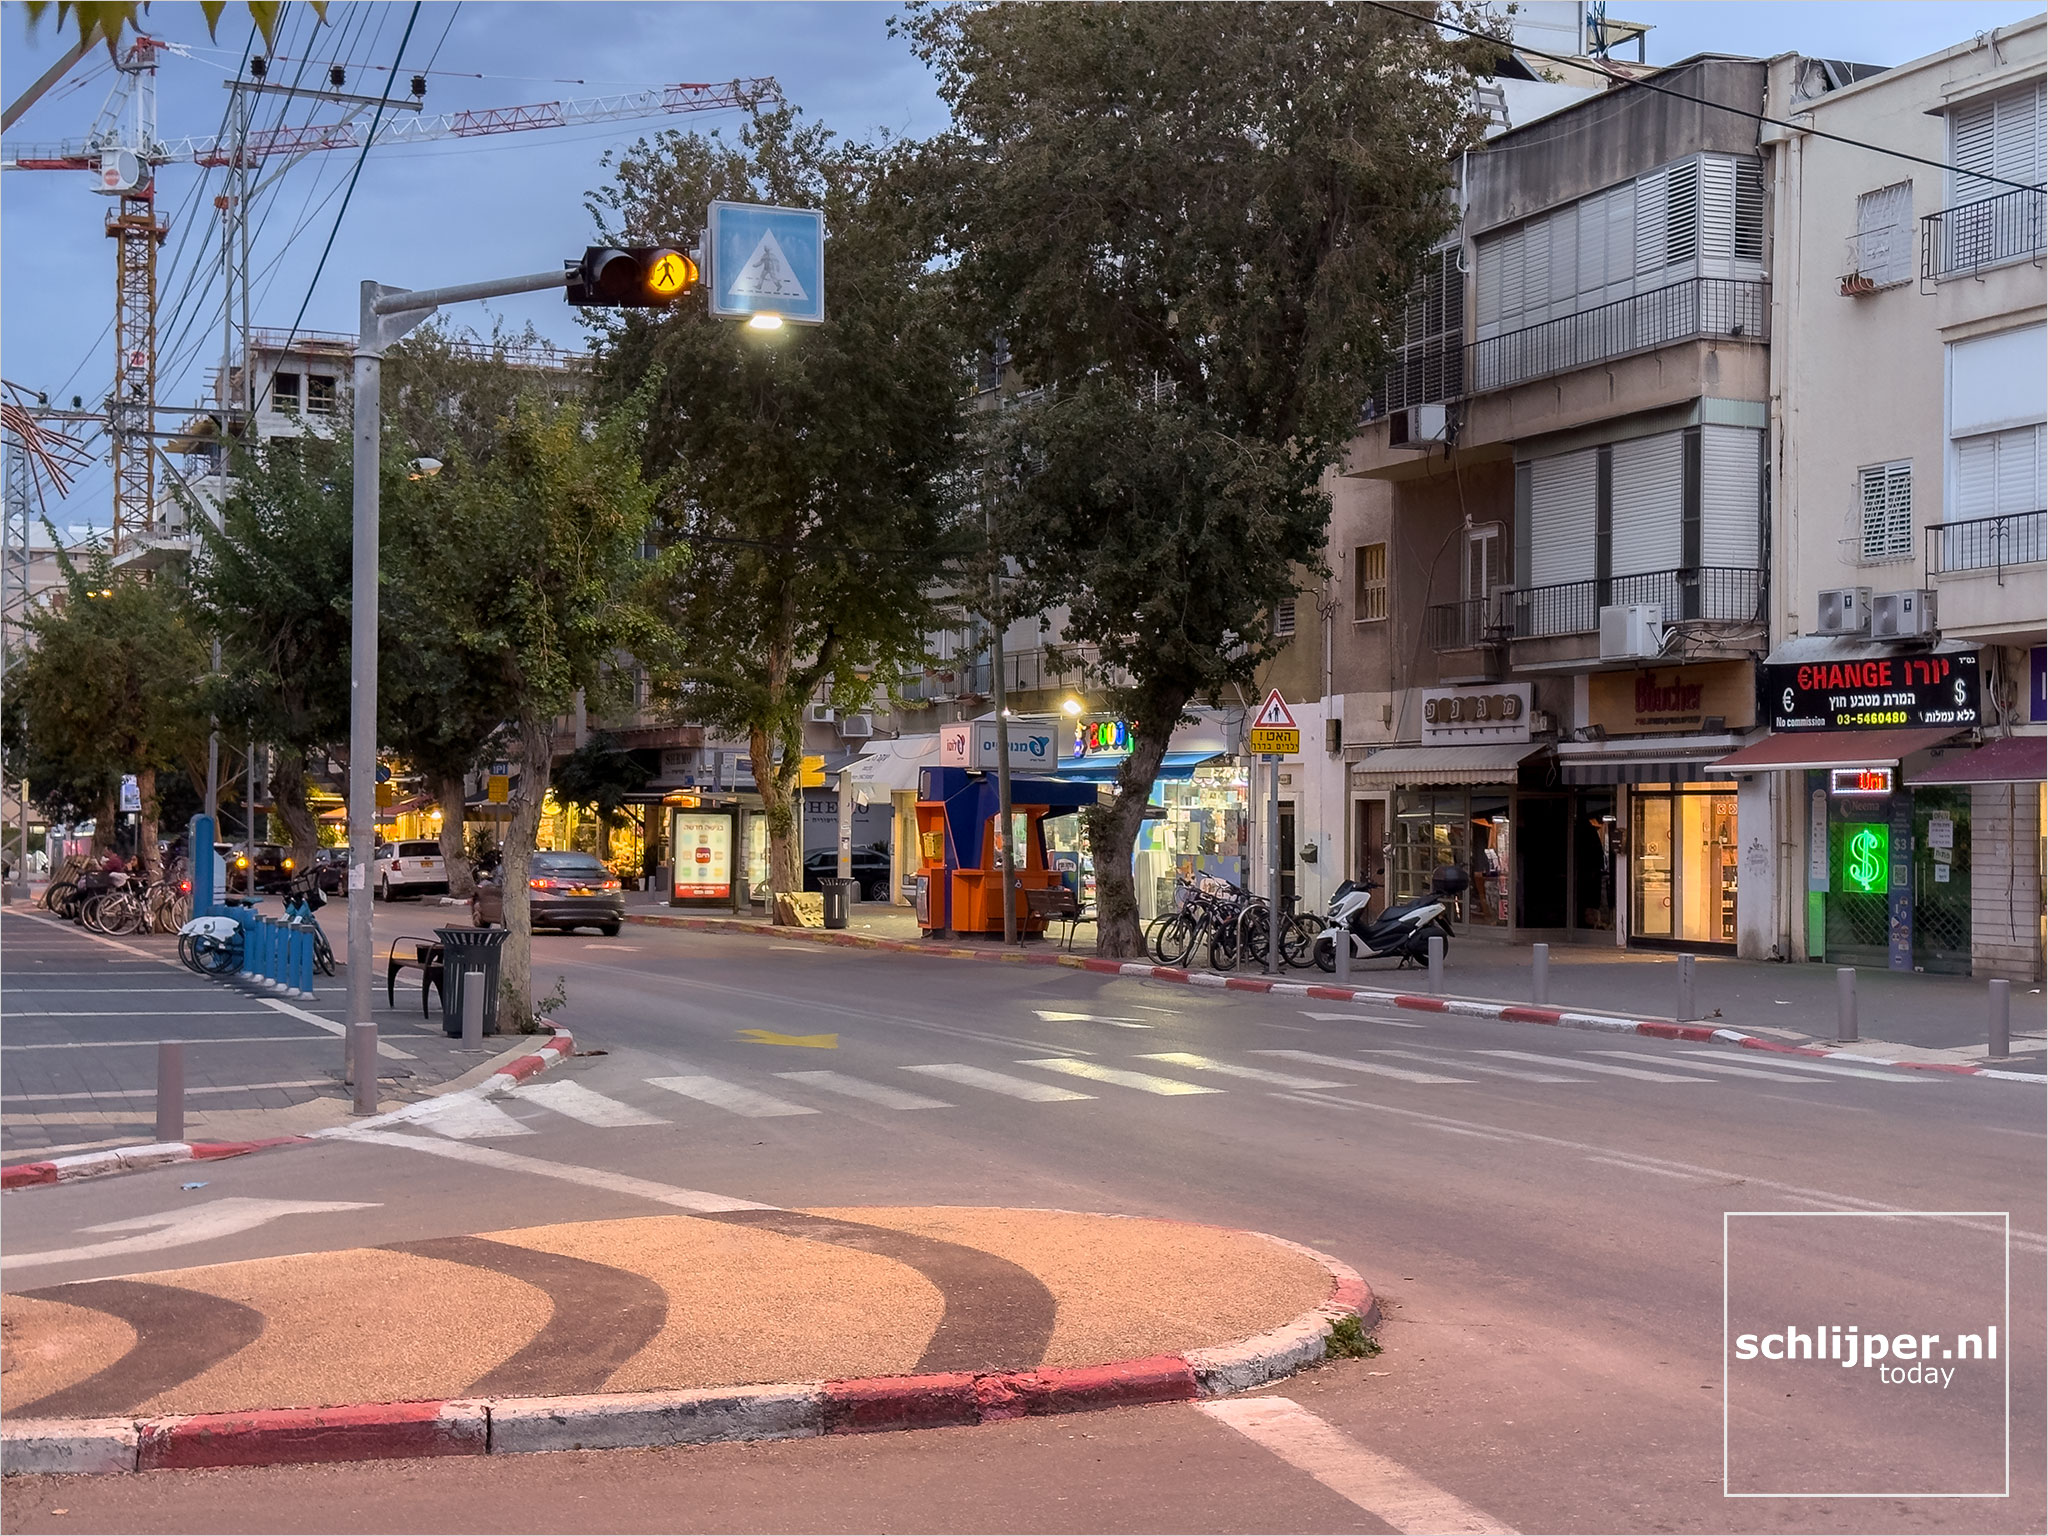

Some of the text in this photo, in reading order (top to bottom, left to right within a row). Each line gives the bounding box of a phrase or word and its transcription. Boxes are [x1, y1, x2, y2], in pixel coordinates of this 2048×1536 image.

[1904, 658, 1949, 686] יורו
[1954, 677, 1966, 706] $
[1782, 687, 1795, 713] €
[1829, 692, 1916, 711] המרת מטבע חוץ
[1776, 716, 1826, 728] No commission
[1836, 711, 1908, 725] 03-5460480
[1925, 709, 1976, 723] ללא עמלות
[803, 801, 870, 815] HEO
[1852, 800, 1880, 811] Neema
